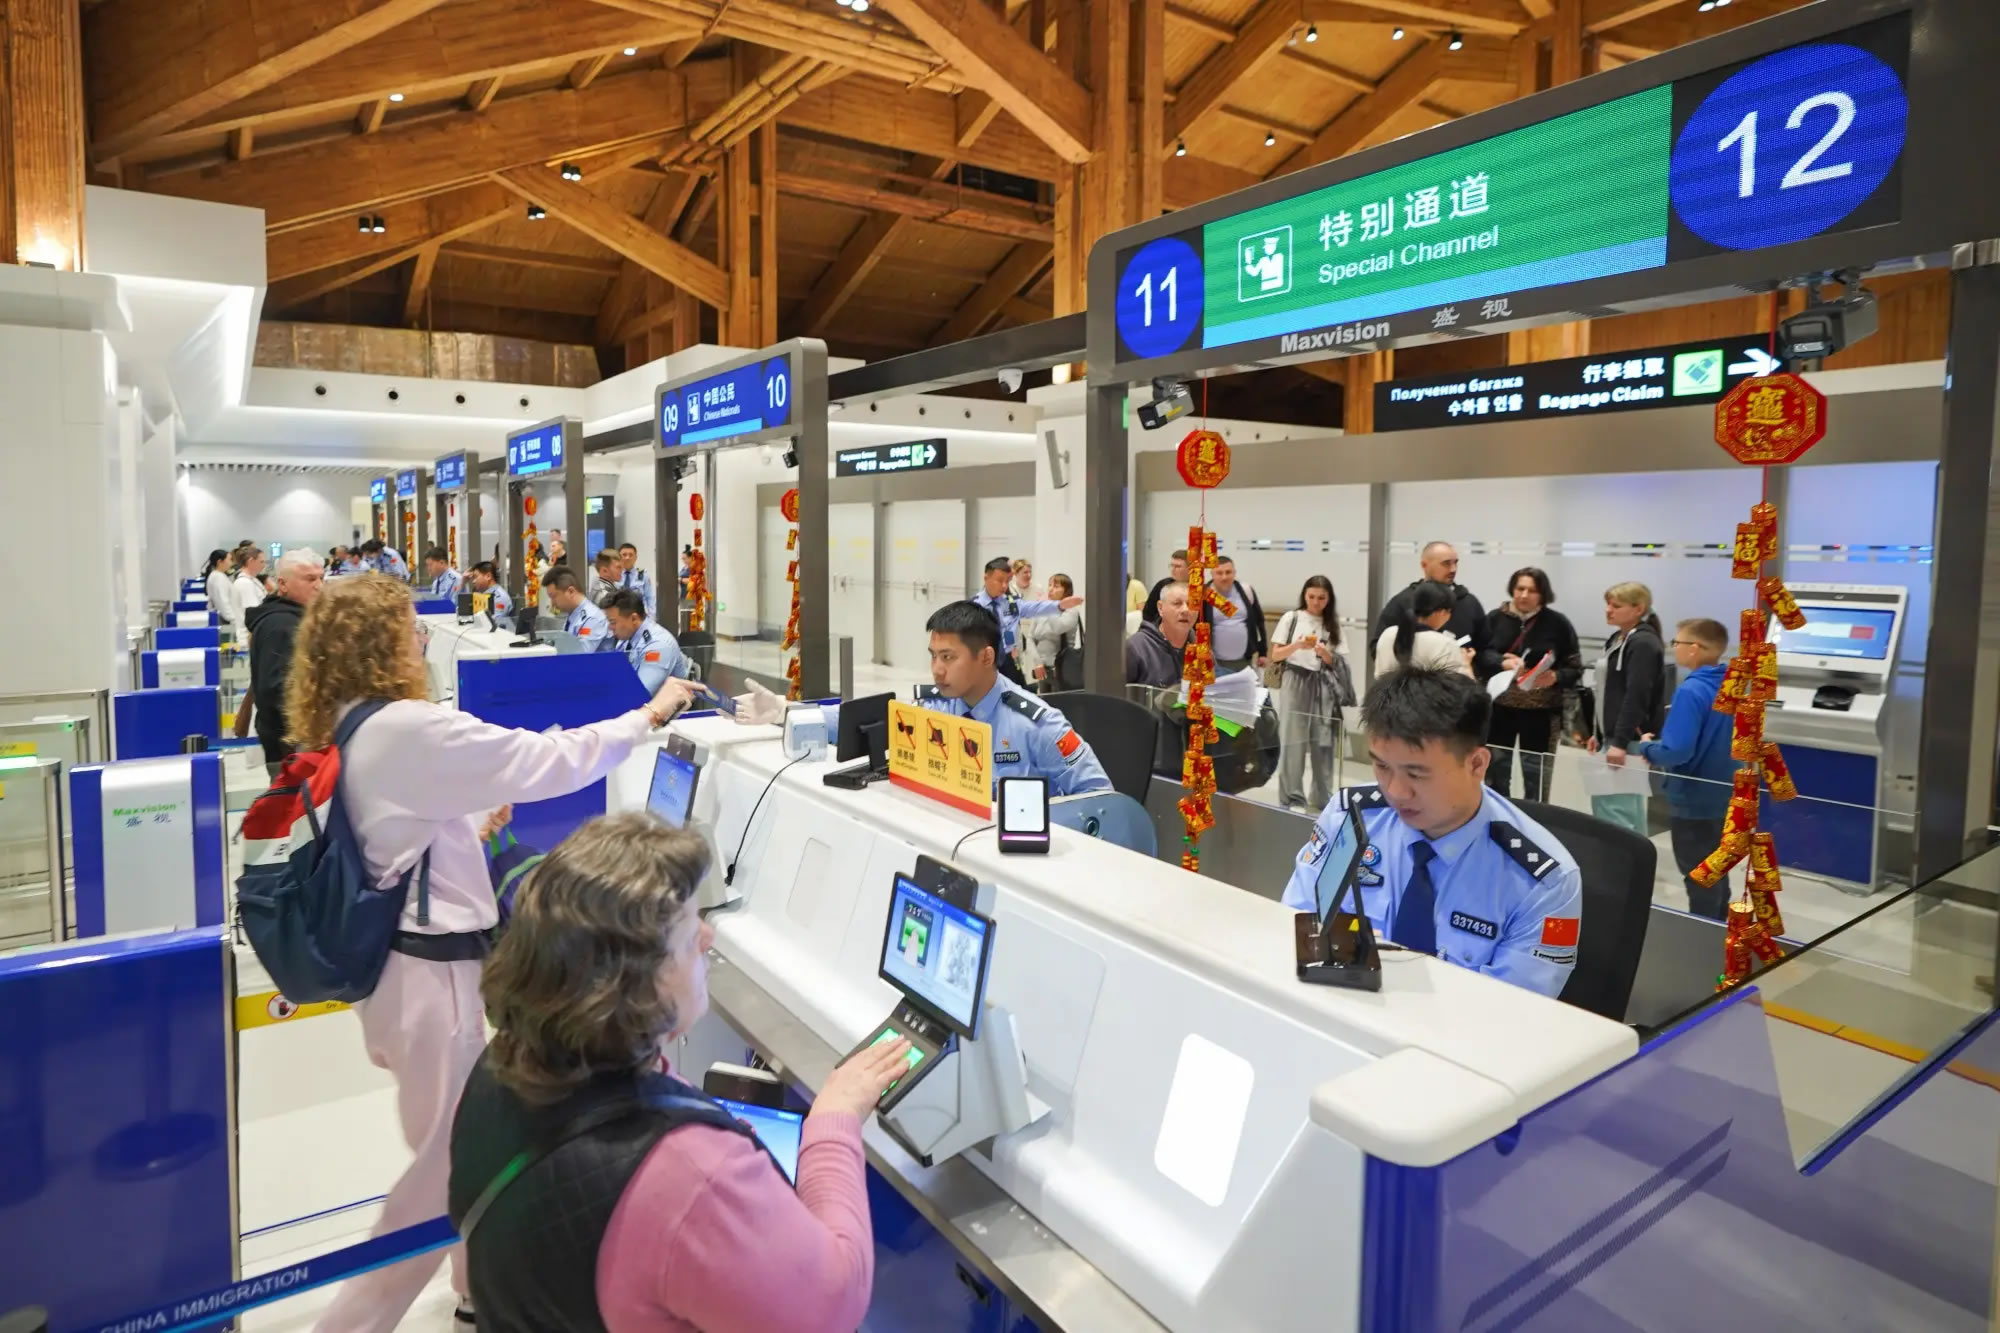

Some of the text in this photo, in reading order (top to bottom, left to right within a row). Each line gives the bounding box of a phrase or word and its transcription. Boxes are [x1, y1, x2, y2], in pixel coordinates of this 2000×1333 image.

[1718, 90, 1857, 199] 12
[1318, 171, 1490, 251] 特别通道
[1318, 226, 1499, 287] Special Channel
[1135, 266, 1177, 327] 11
[1280, 320, 1390, 353] Maxvision
[703, 382, 736, 407] 中国公民
[766, 373, 787, 409] 10
[1390, 376, 1524, 402] Получение багажа
[1538, 385, 1665, 410] Baggage Claim
[663, 404, 679, 433] 09
[112, 803, 177, 817] Maxvision
[1452, 914, 1493, 937] 337431
[173, 1266, 309, 1322] IMMIGRATION
